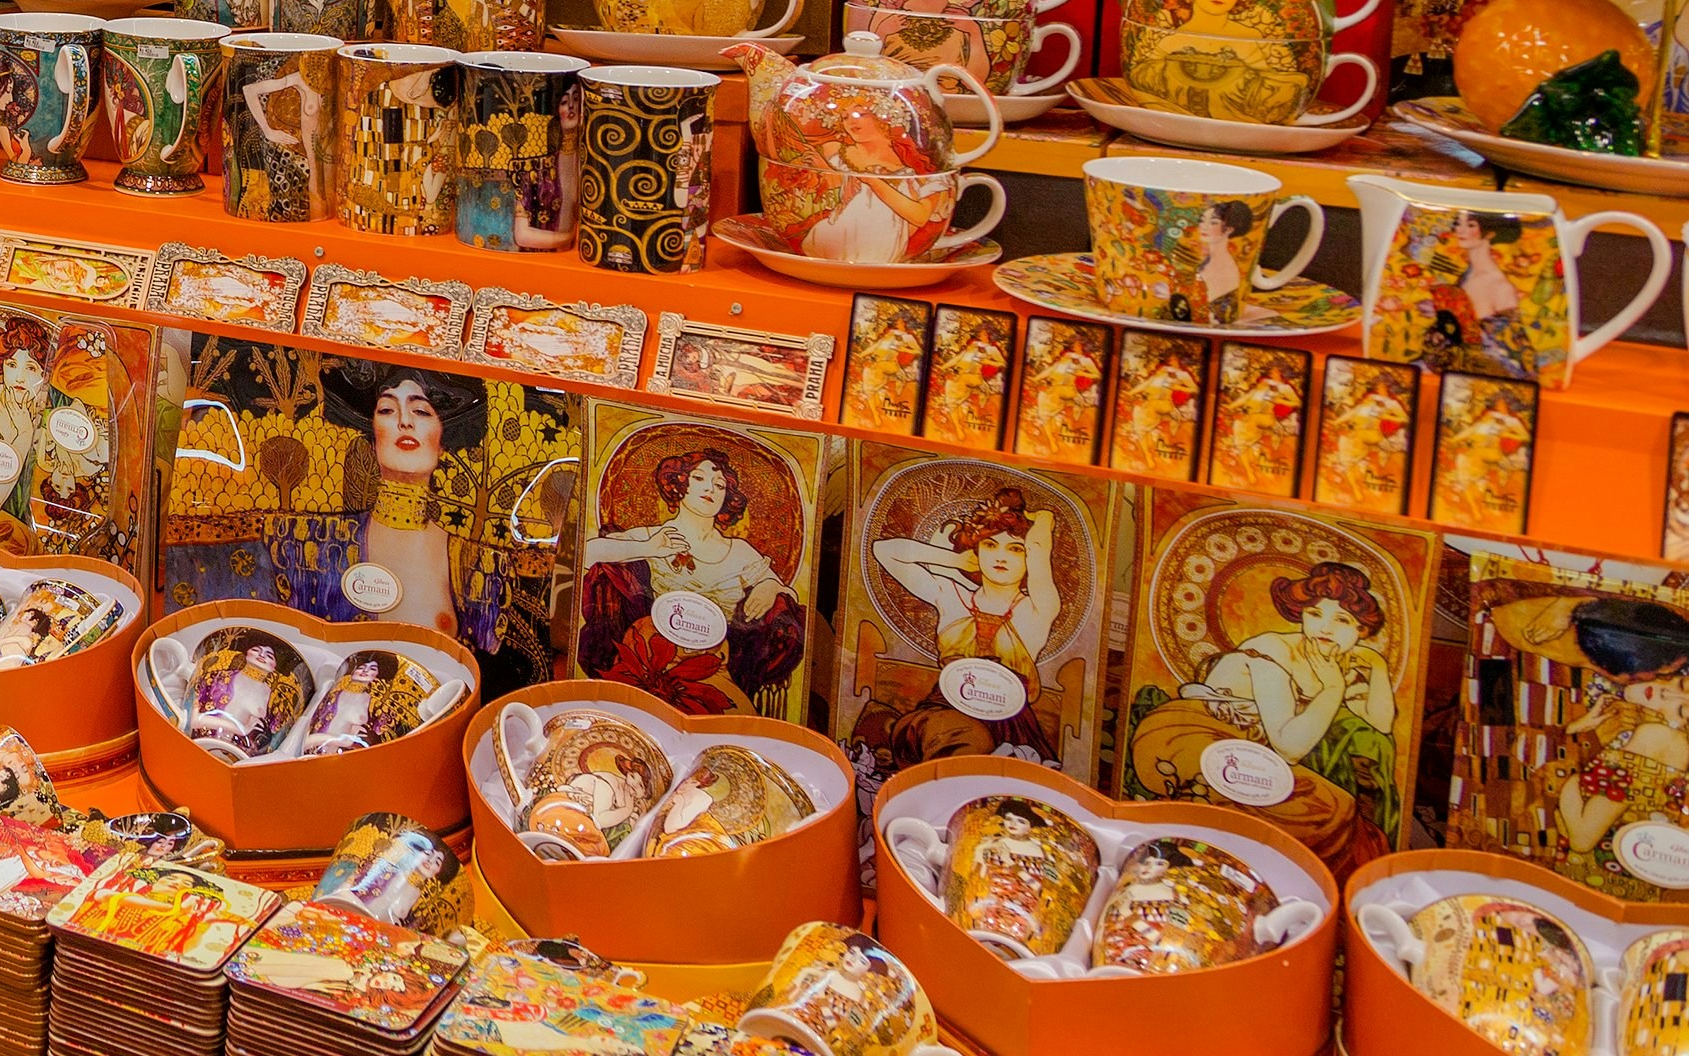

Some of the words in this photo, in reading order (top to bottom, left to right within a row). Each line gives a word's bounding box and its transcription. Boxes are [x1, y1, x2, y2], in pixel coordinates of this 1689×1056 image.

[805, 359, 824, 400] PRAHA
[352, 578, 390, 595] Carmani
[669, 612, 711, 634] Carmani
[959, 682, 1007, 704] Carmani
[1222, 764, 1272, 788] Carmani
